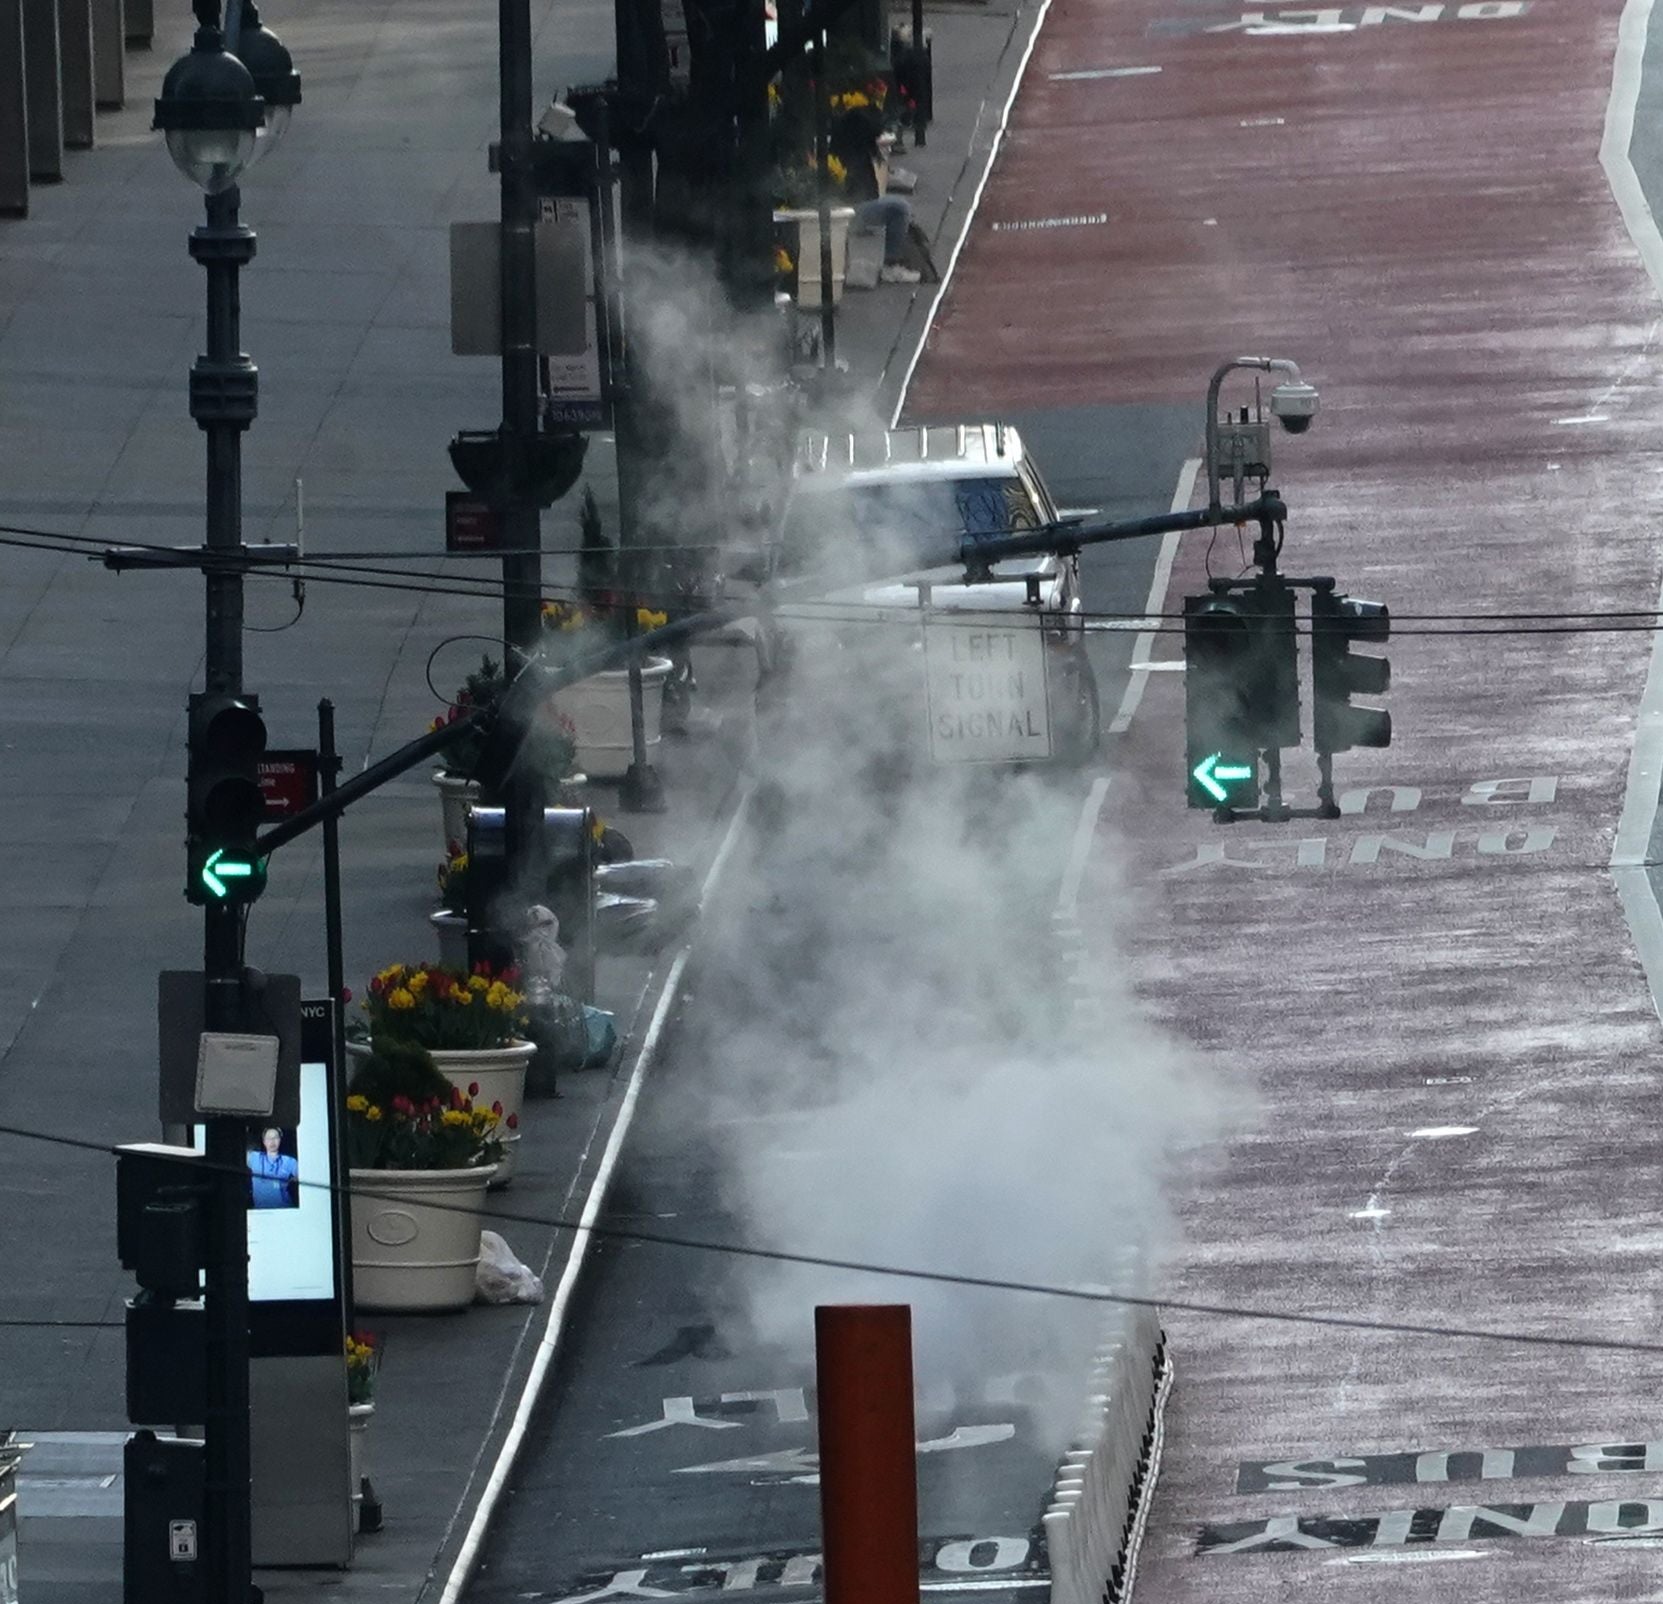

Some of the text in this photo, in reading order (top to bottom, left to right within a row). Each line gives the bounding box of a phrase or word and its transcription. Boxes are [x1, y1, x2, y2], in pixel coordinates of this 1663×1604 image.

[952, 633, 1016, 661] LEFT
[939, 710, 1041, 739] SIGNAL
[257, 762, 295, 774] TANDING
[1160, 825, 1559, 874] ONLY
